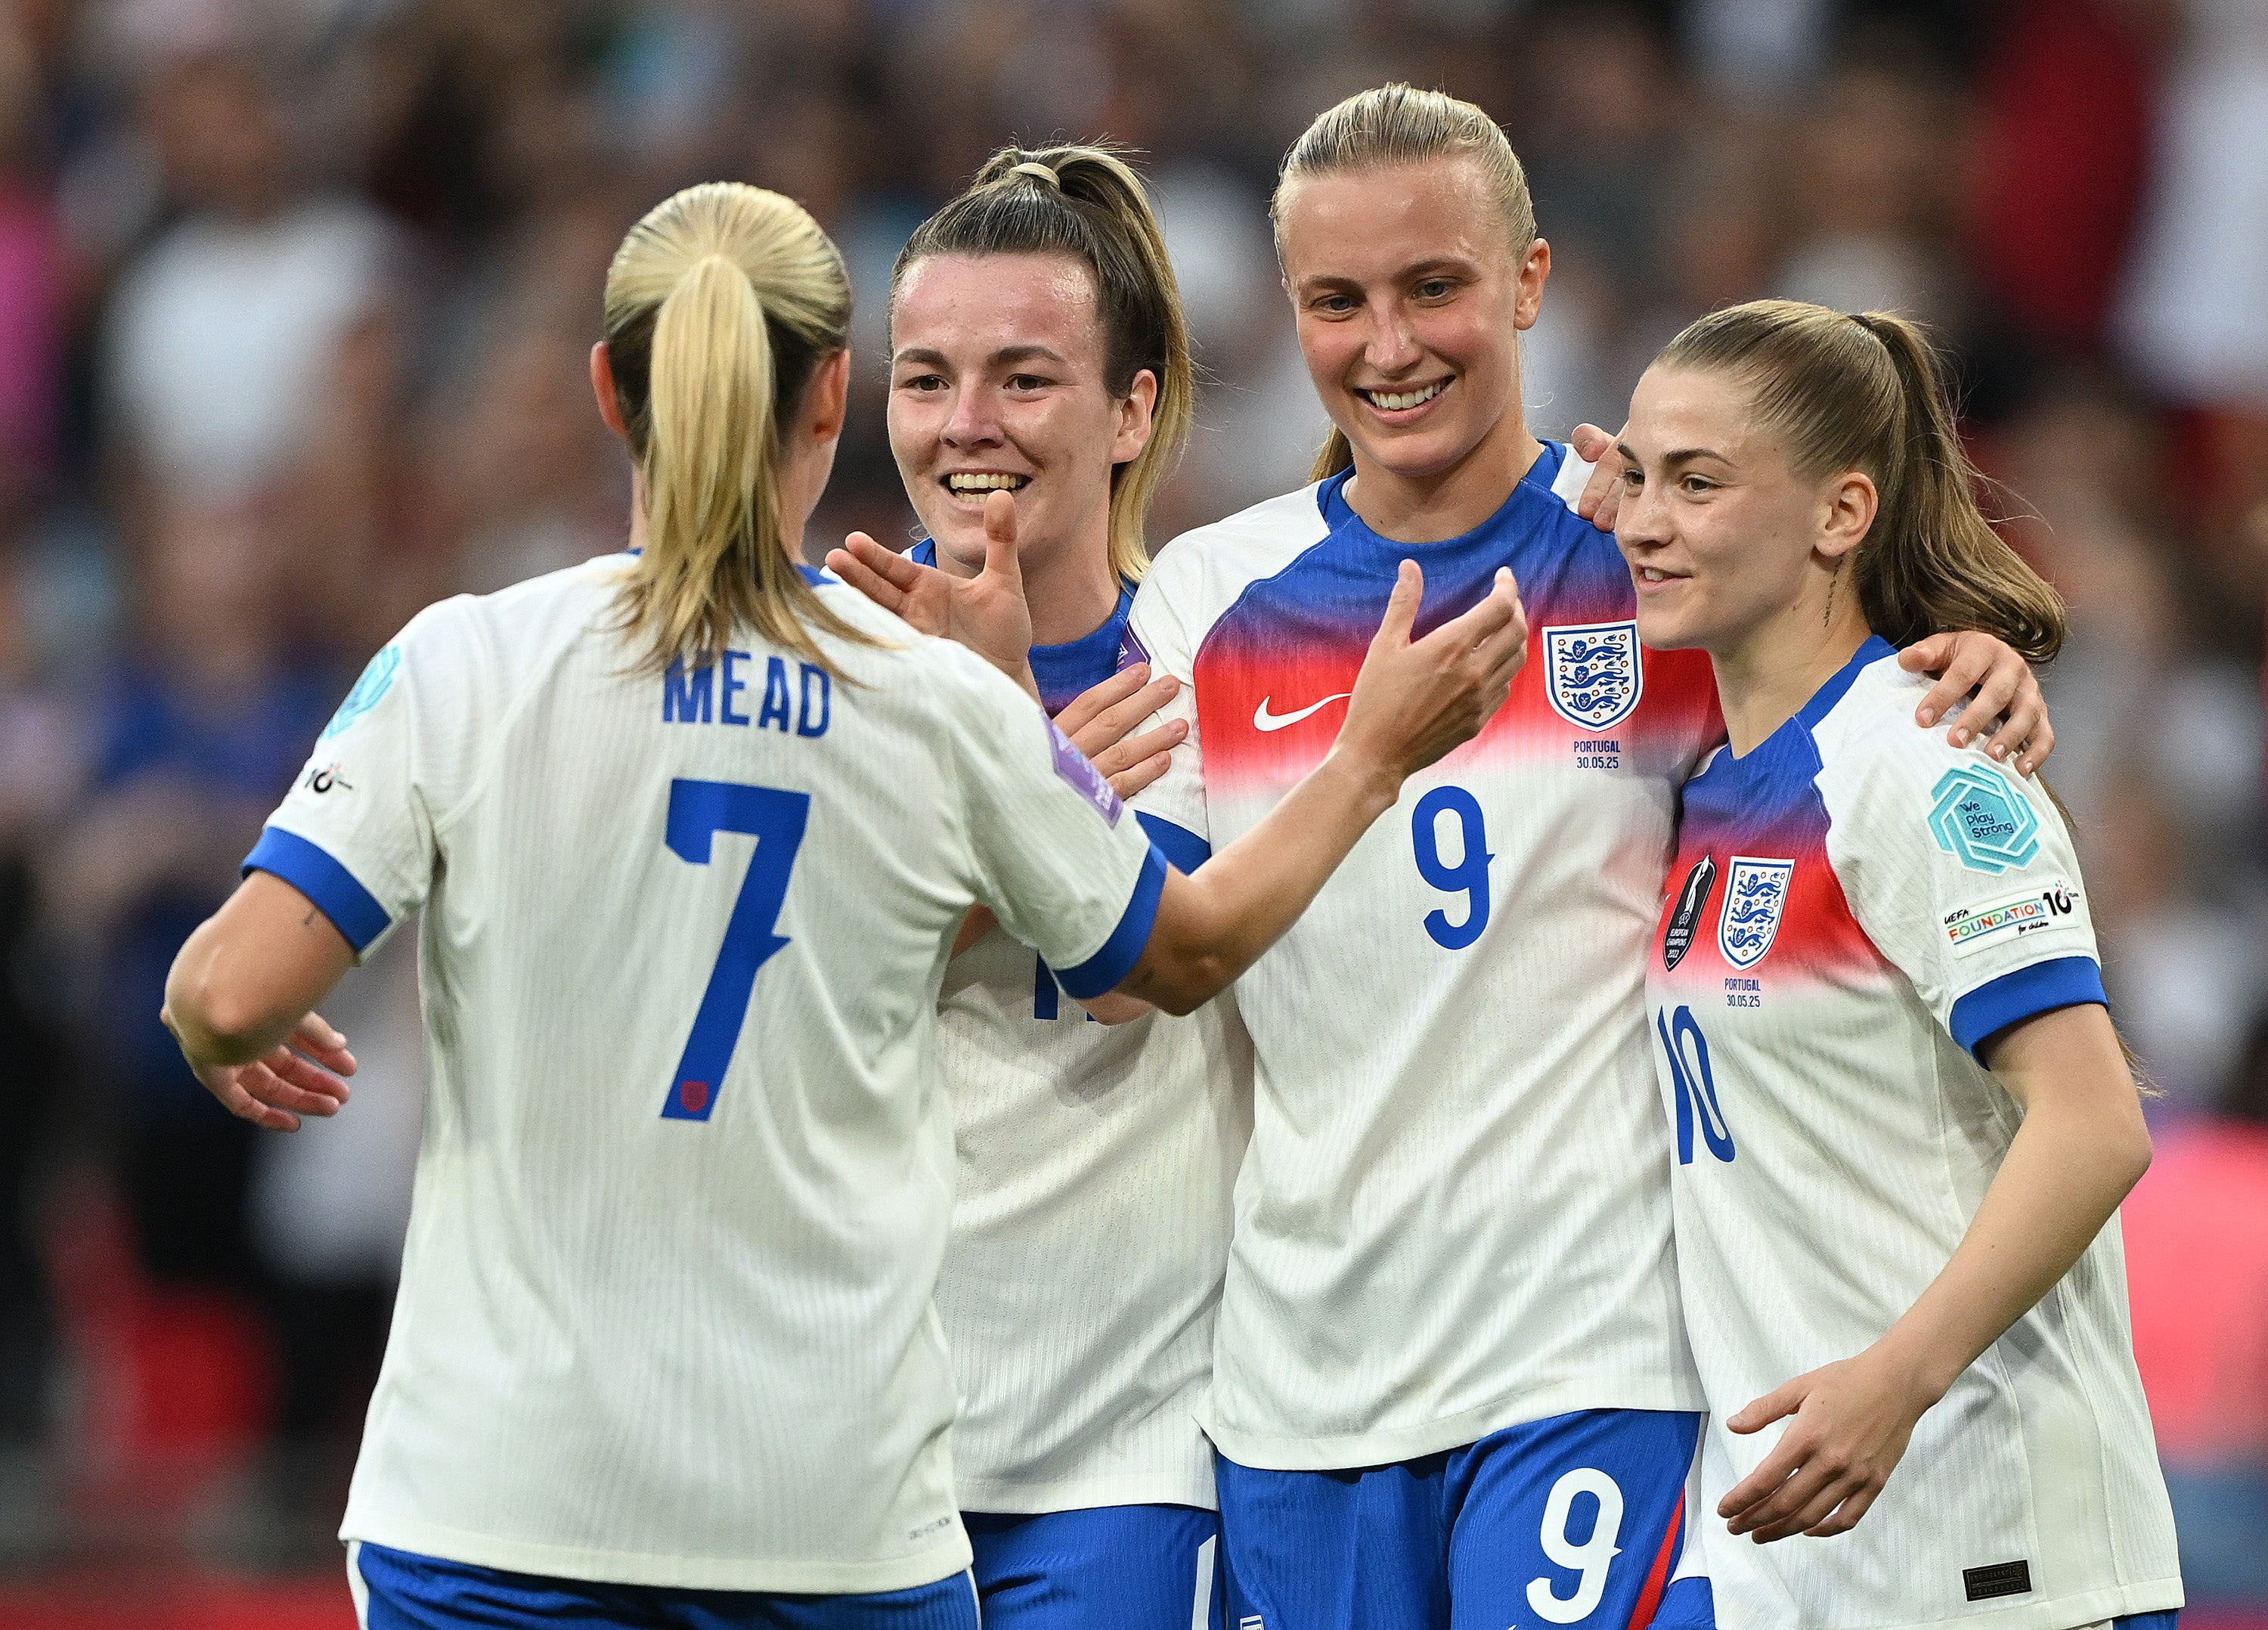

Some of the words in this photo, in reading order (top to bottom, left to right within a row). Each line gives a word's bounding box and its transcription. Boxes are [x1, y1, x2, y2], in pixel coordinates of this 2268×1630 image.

[662, 650, 830, 739] MEAD
[1573, 740, 1621, 753] PORTUGAL
[1576, 757, 1619, 769] 30.05.25
[1959, 801, 1981, 813] We
[1966, 813, 1995, 826] Play
[1972, 823, 2014, 838] Strong
[1411, 786, 1495, 950] 9
[2043, 888, 2071, 916] 10
[1944, 909, 1969, 925] UEFA
[1949, 903, 2044, 941] FOUNDATION
[661, 778, 810, 1122] 7
[1724, 978, 1761, 991] PORTUGAL
[1727, 994, 1761, 1008] 30.05.25
[1657, 1005, 1736, 1165] 10
[1526, 1467, 1623, 1624] 9
